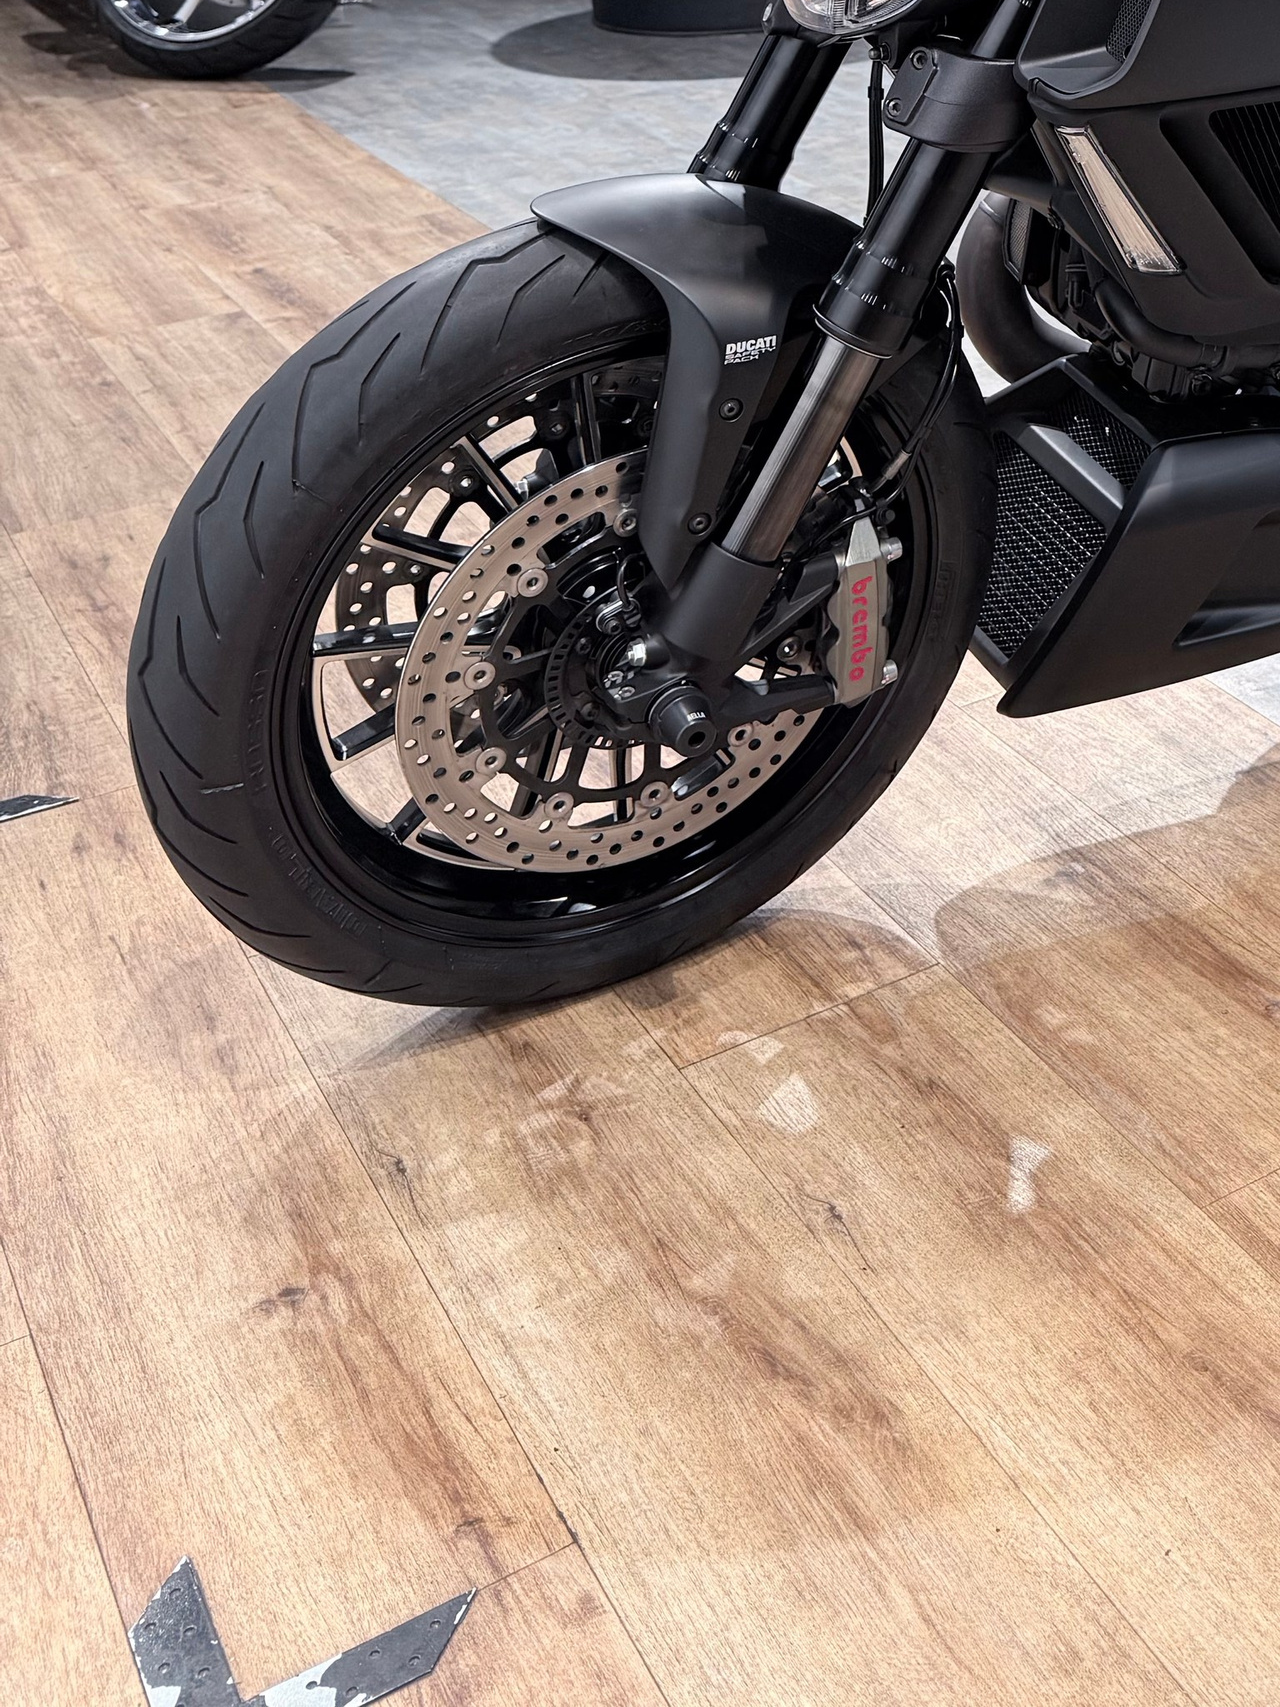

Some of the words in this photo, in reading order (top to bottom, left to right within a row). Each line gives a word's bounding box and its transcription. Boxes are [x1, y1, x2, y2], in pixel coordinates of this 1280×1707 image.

[725, 335, 777, 355] DUCATI
[725, 346, 777, 360] SAFETY
[850, 575, 874, 682] brembo
